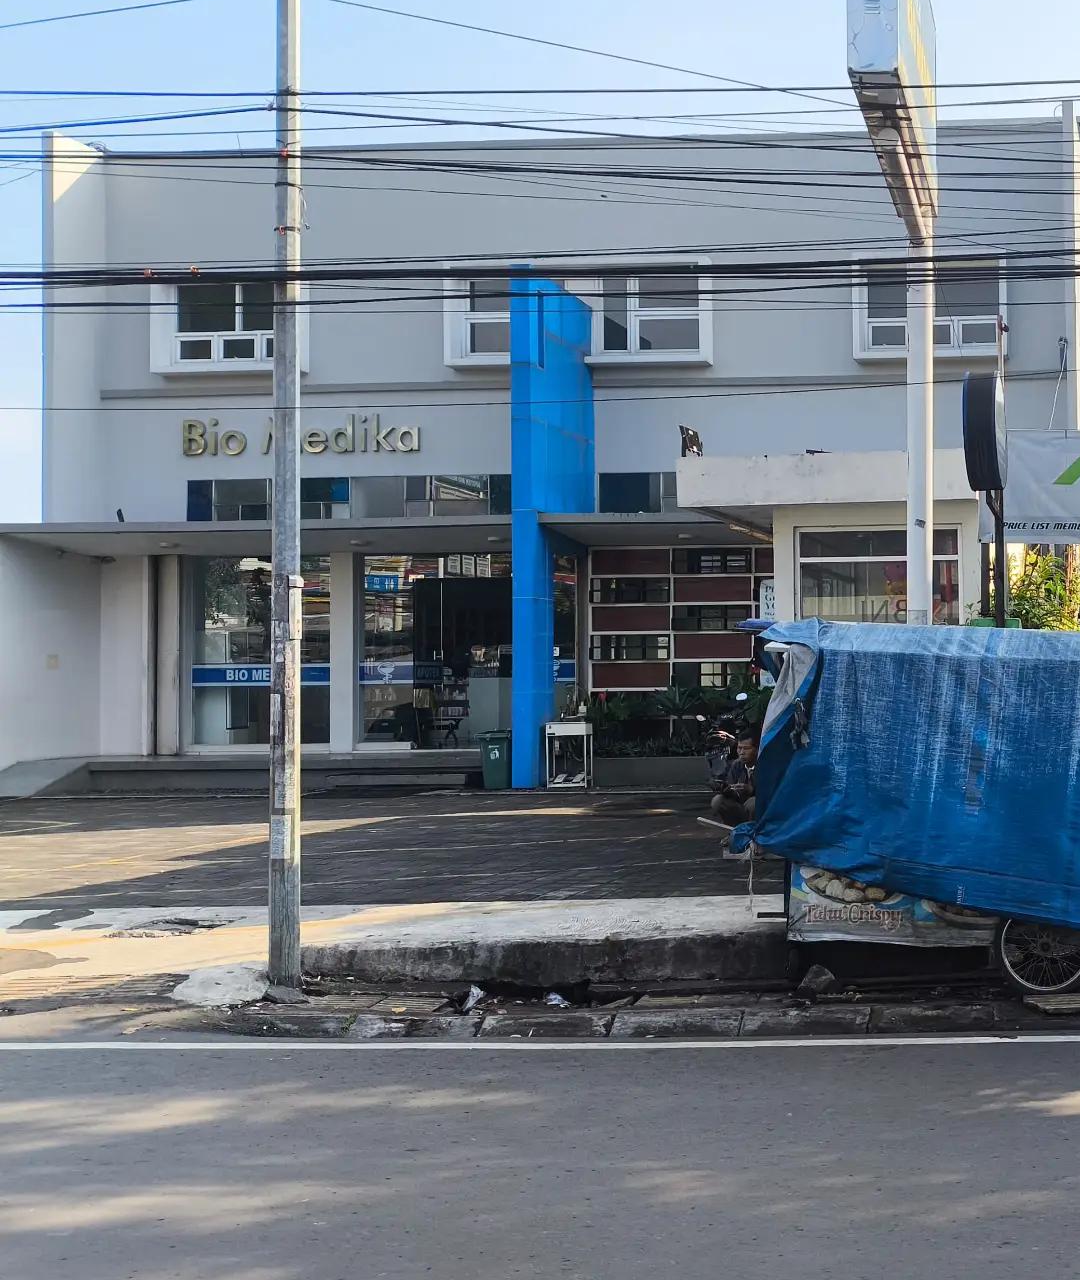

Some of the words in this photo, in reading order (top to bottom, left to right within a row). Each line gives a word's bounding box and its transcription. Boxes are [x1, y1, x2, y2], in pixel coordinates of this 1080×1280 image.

[183, 418, 247, 456] Bio
[1002, 521, 1027, 531] PRICE
[1031, 521, 1050, 531] LIST
[226, 669, 248, 681] BIO
